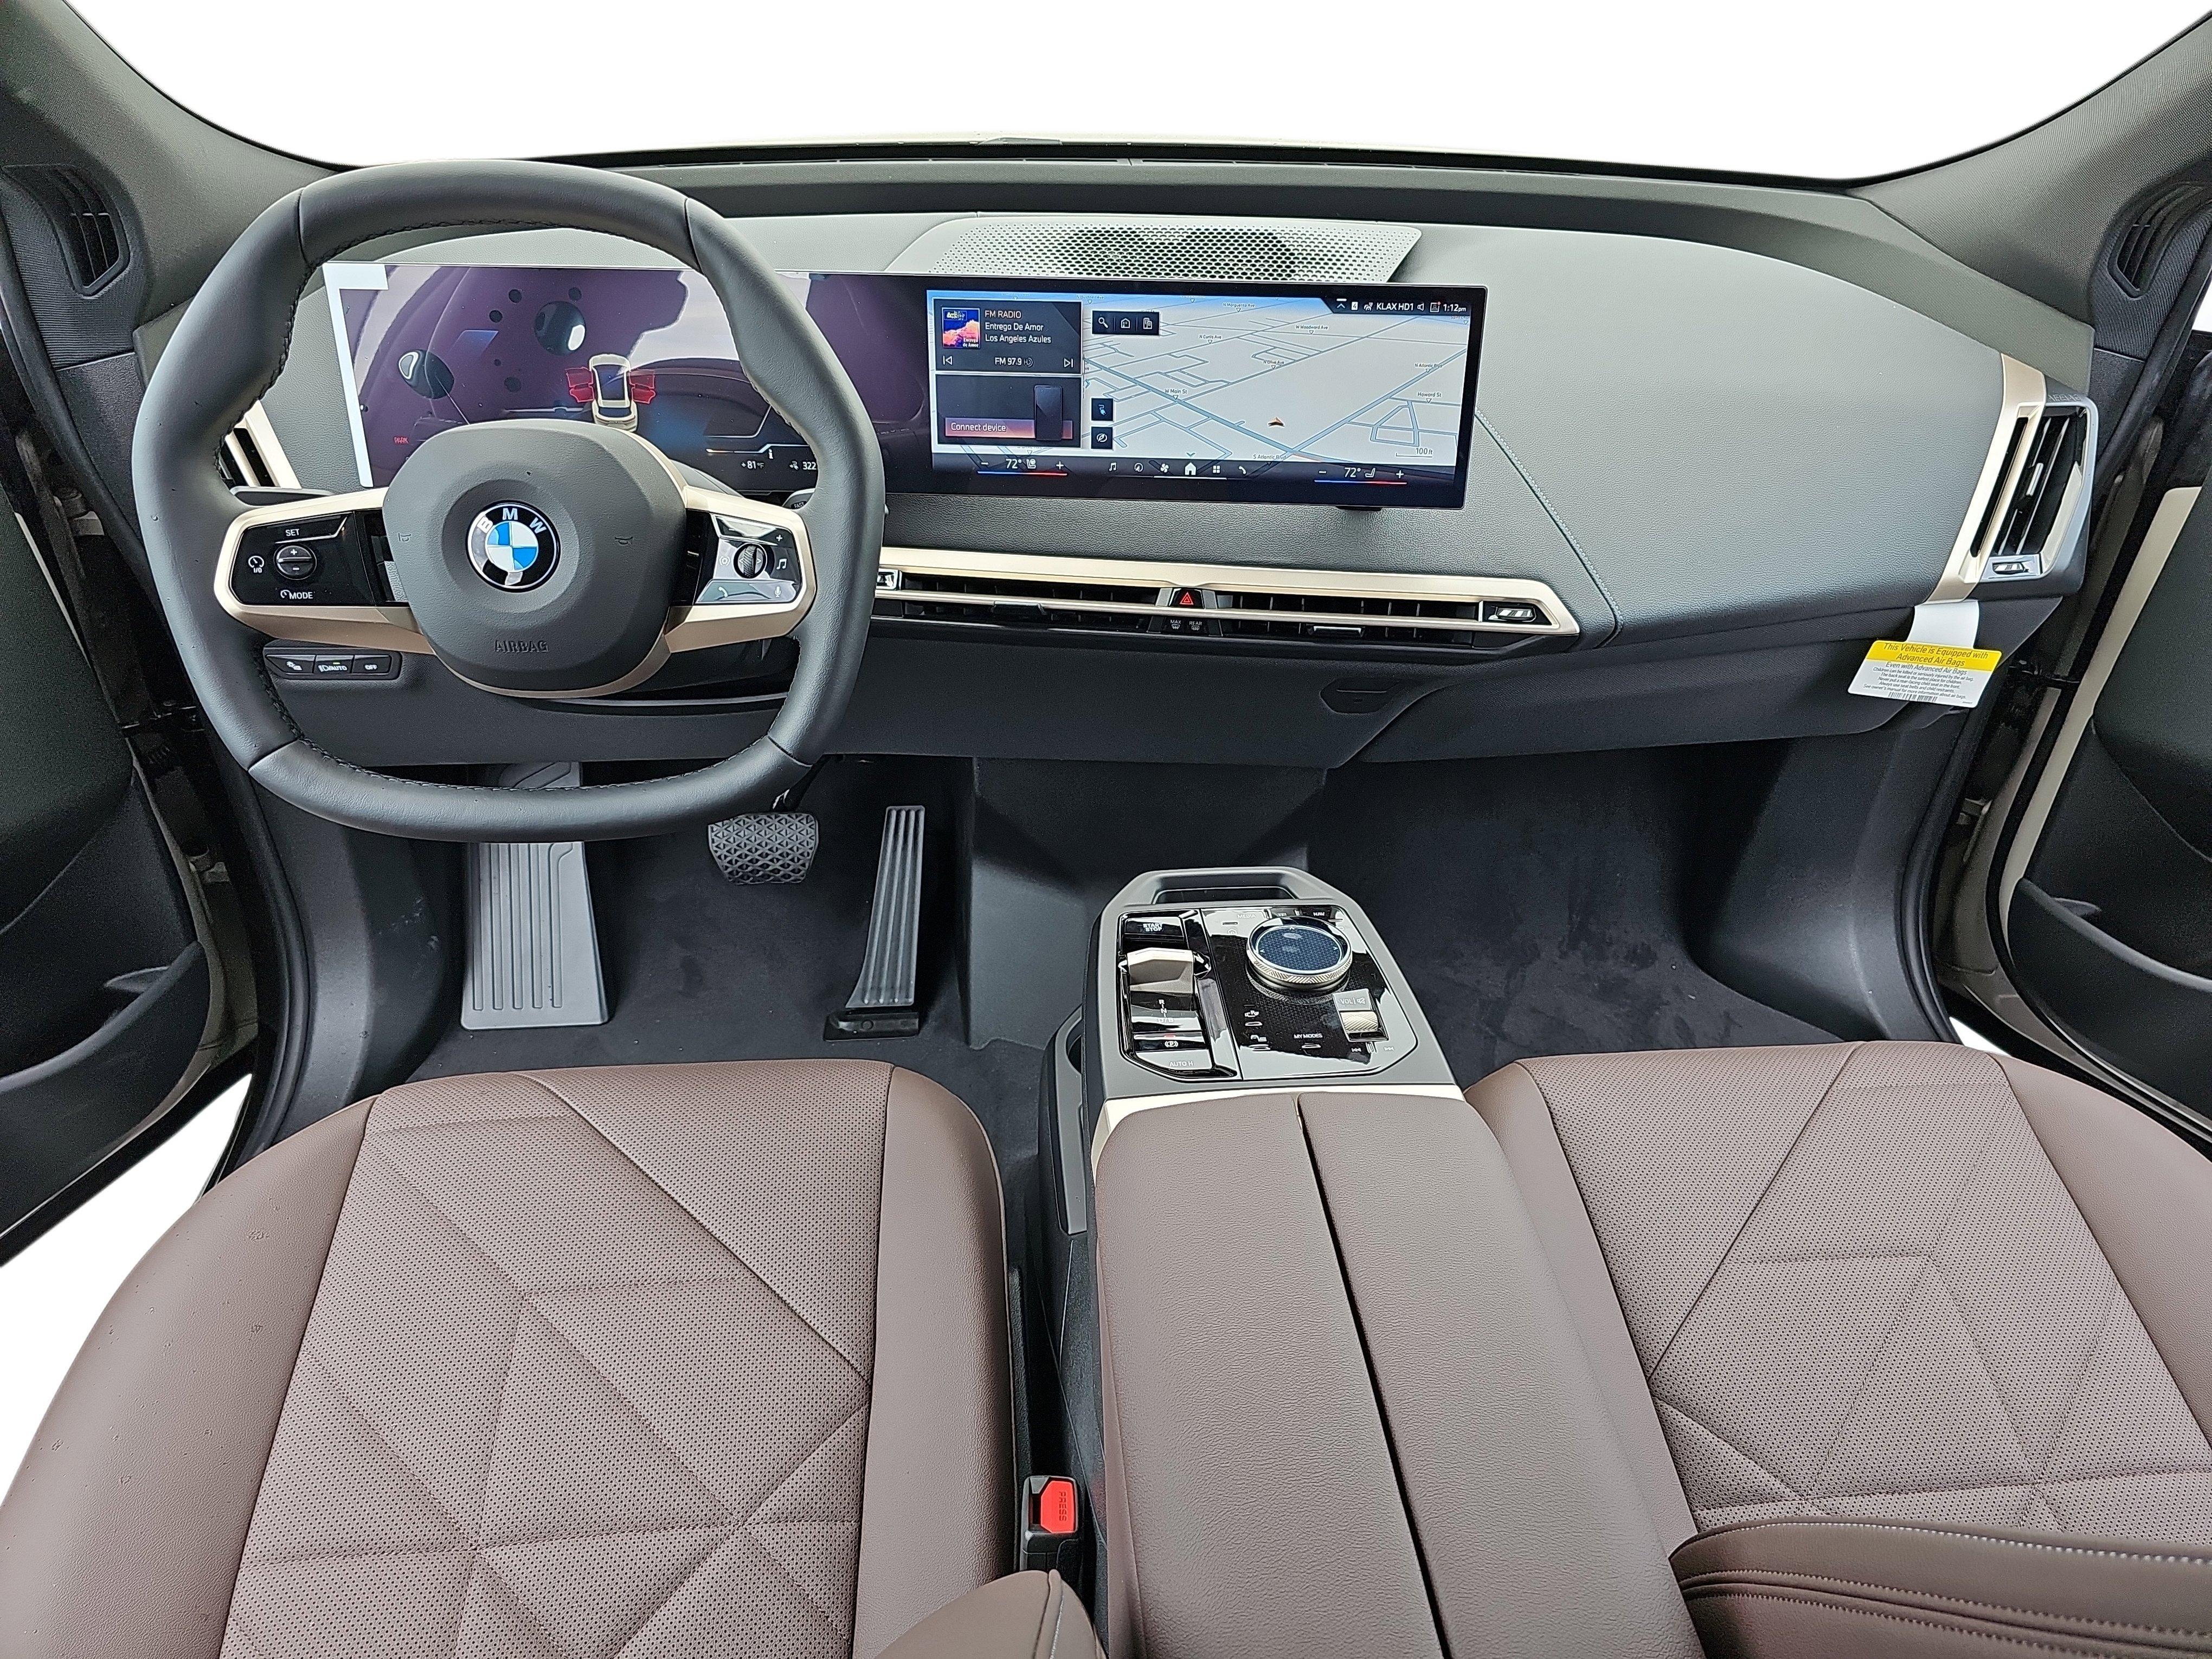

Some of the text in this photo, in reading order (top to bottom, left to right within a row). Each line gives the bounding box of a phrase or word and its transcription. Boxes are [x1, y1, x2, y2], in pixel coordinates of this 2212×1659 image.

[1377, 303, 1398, 311] KLAX
[985, 323, 1012, 332] Entrega
[999, 335, 1026, 344] Angeles
[802, 462, 816, 470] 322
[477, 508, 547, 534] BMW
[288, 591, 314, 600] MODE
[494, 640, 548, 653] AIRBAG
[1884, 642, 1899, 651] This
[1900, 644, 1927, 653] Vehicle
[1936, 647, 1972, 658] Equipped
[1895, 653, 1934, 663] Advanced
[1946, 658, 1965, 667] Bags
[1913, 664, 1943, 673] Advanced
[1059, 1491, 1067, 1521] PRESS
